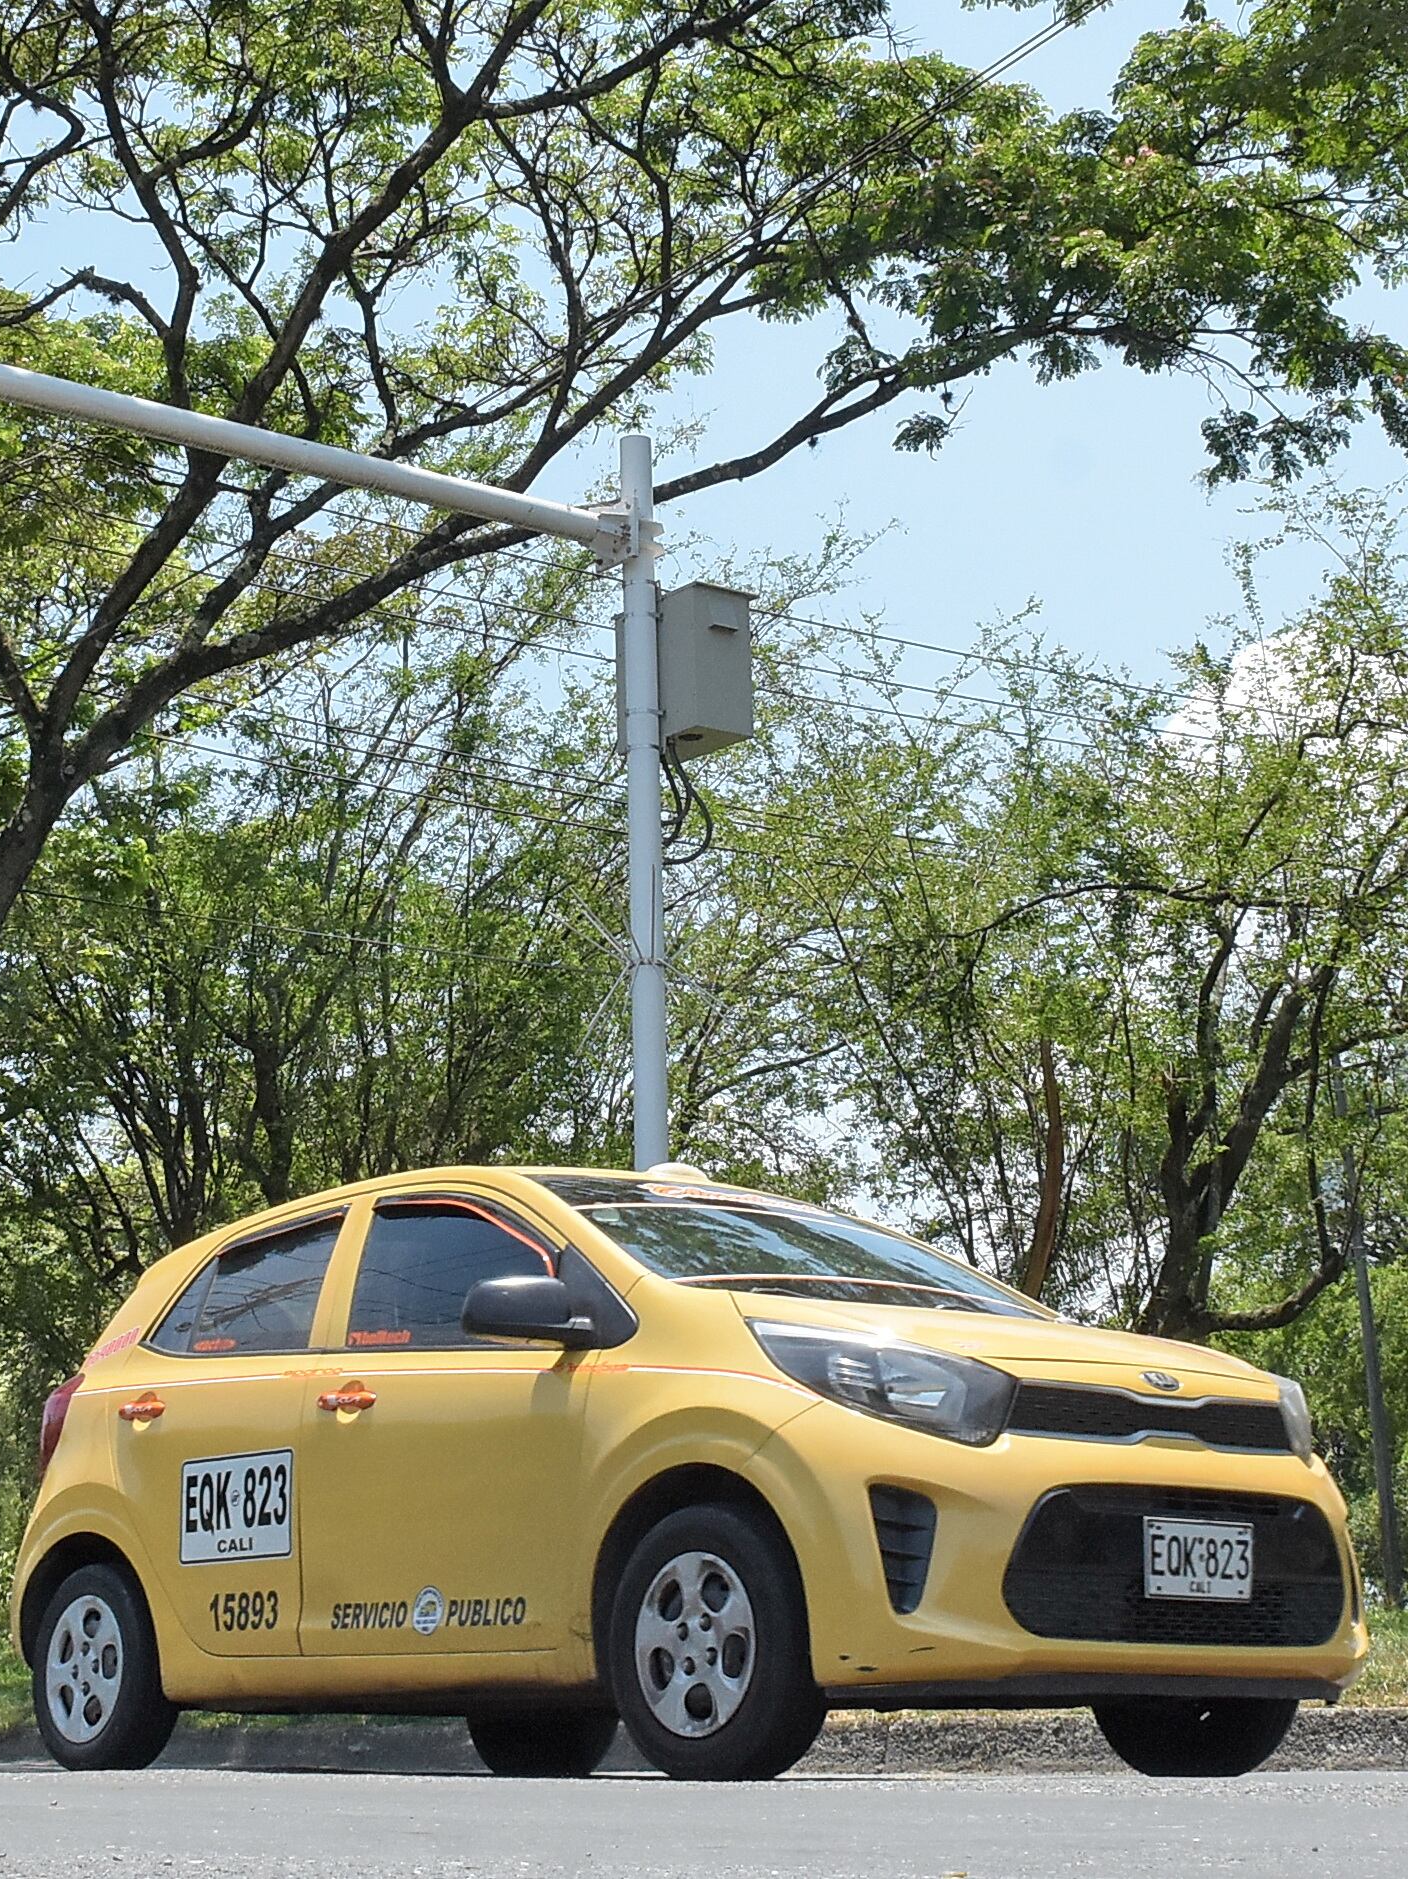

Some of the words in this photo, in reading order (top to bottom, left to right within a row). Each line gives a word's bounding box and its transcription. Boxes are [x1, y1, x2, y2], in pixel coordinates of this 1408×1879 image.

[185, 1470, 233, 1535] EQK
[242, 1464, 287, 1528] 823
[217, 1537, 253, 1553] CALI
[1151, 1534, 1197, 1578] EQK
[1205, 1538, 1249, 1580] 823
[209, 1590, 279, 1632] 15893
[330, 1601, 408, 1630] SERVICIO
[445, 1596, 527, 1627] PUBLICO
